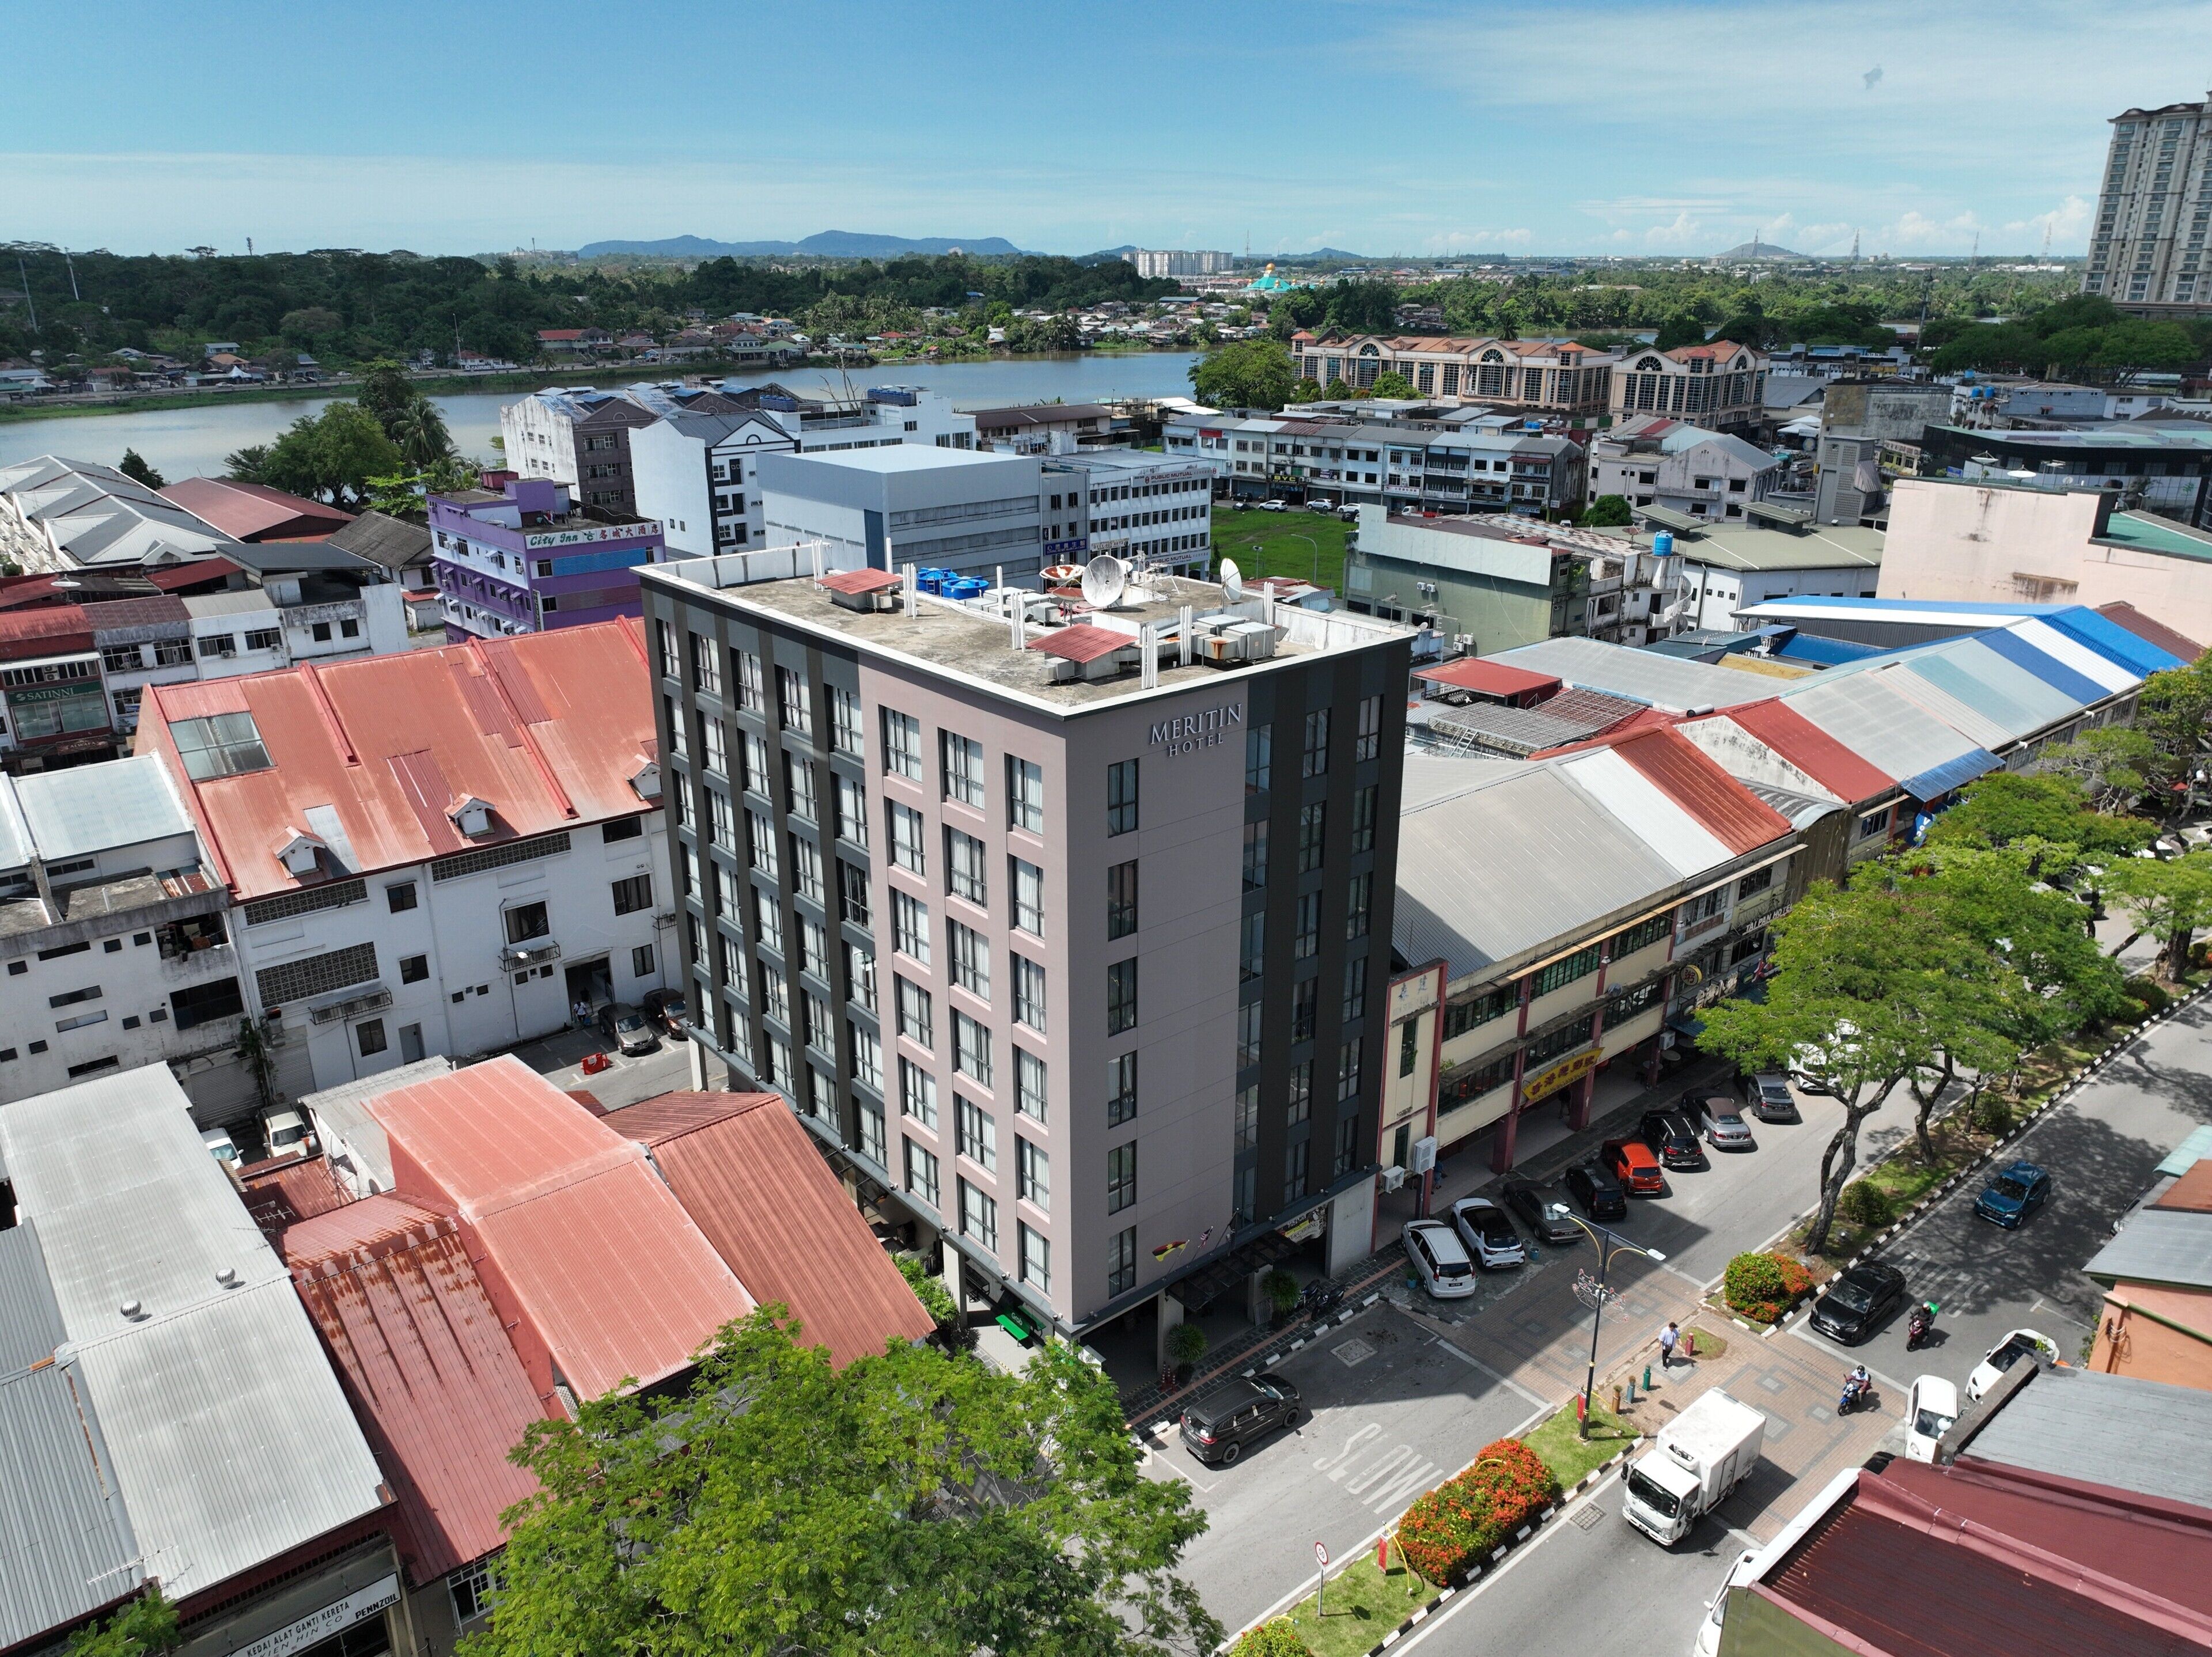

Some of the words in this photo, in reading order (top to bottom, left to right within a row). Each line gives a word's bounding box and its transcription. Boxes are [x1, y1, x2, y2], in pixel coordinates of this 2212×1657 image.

[530, 533, 555, 546] City
[560, 533, 578, 543] Inn
[1171, 554, 1192, 562] MUTUAL
[27, 687, 74, 700] SATINNI
[1150, 704, 1241, 745] MERITIN
[1169, 733, 1224, 757] HOTEL
[1745, 921, 1757, 932] TAI
[1758, 913, 1772, 926] PAN
[1773, 903, 1793, 919] HOTEL
[1012, 1313, 1022, 1326] Grab
[1312, 1422, 1444, 1515] SLOW
[1319, 1548, 1324, 1559] 50
[355, 1593, 398, 1619] PENNZOIL
[247, 1640, 270, 1657] KEDAI
[274, 1629, 293, 1645] ALAT
[296, 1618, 319, 1634] GANTI
[321, 1601, 350, 1621] KERETA
[297, 1626, 319, 1643] HIN
[325, 1615, 342, 1627] CO
